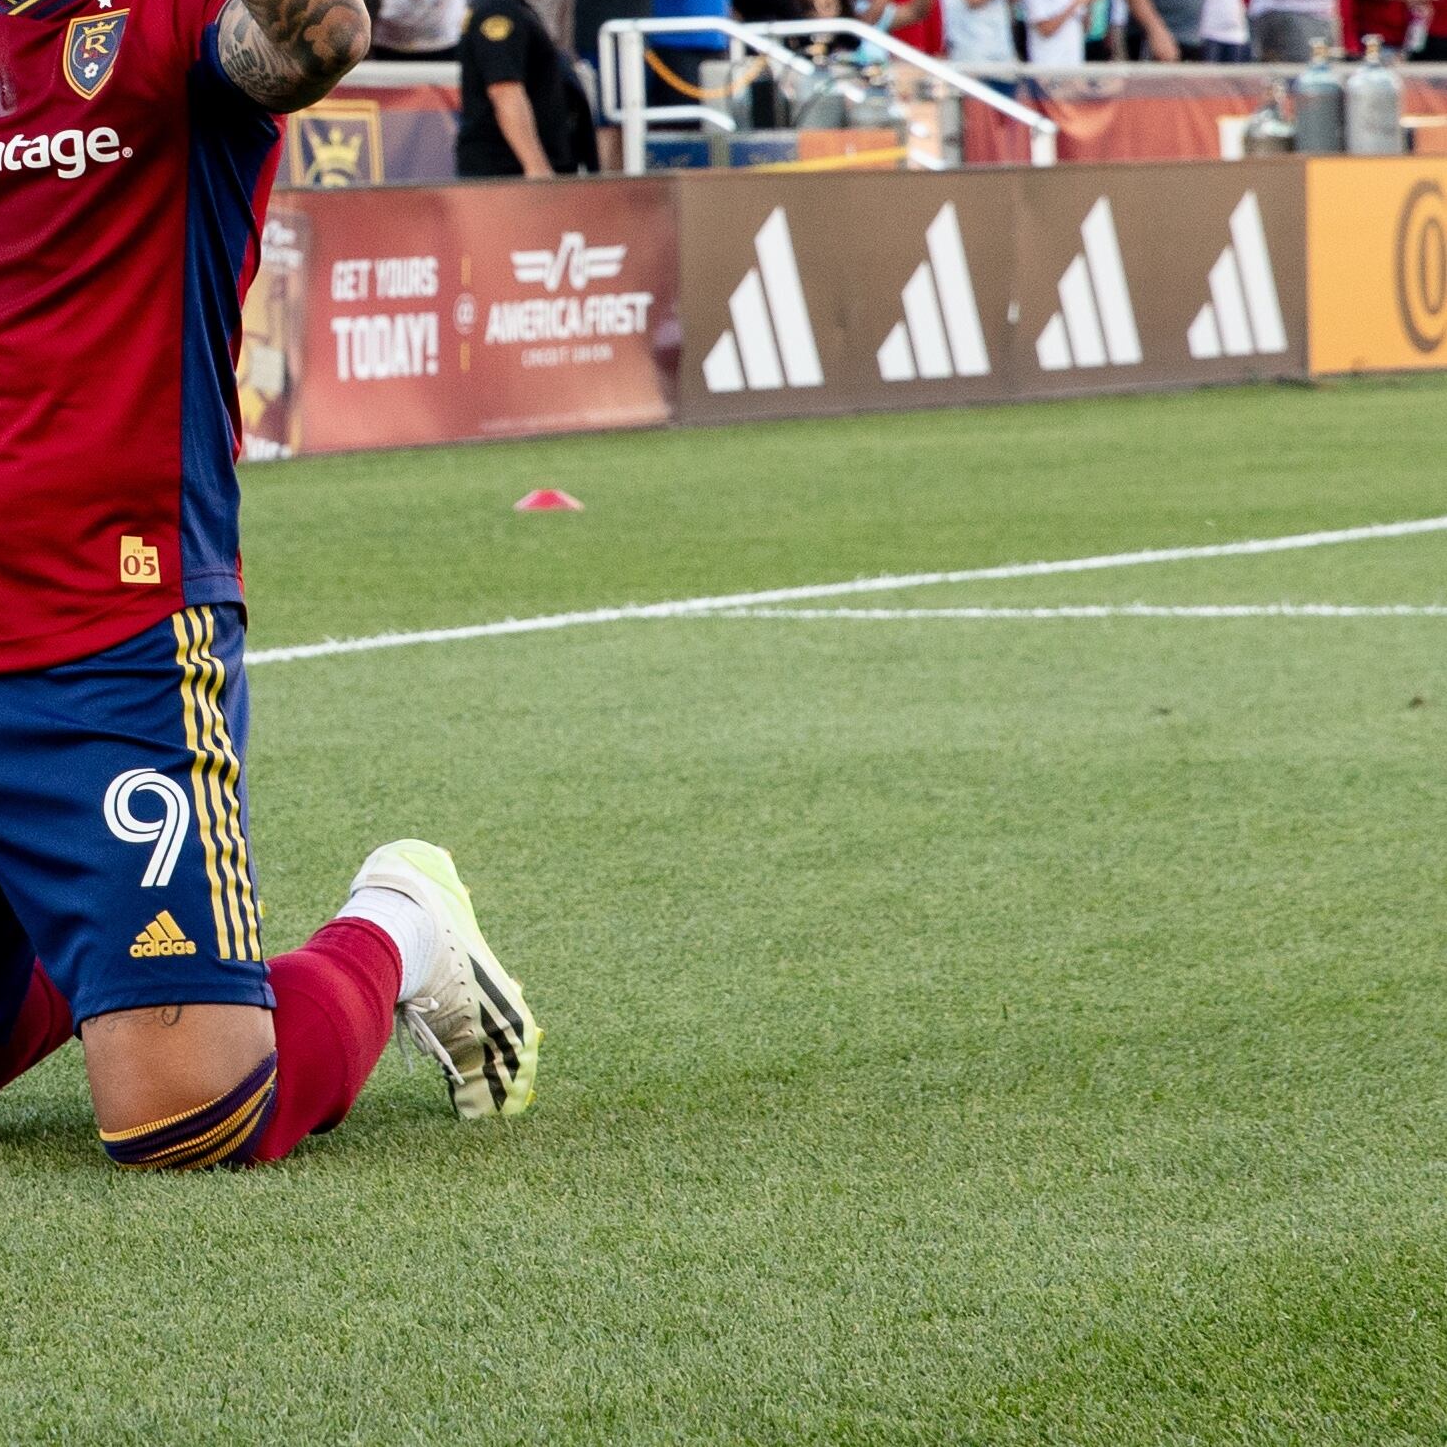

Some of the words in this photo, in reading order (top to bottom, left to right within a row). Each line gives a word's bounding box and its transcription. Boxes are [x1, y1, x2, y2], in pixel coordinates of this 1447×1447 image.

[330, 258, 372, 303] GET
[374, 255, 440, 299] YOURS
[329, 311, 440, 383] TODAY!
[123, 554, 157, 577] 05
[103, 767, 191, 888] 9
[130, 937, 197, 959] adidas
